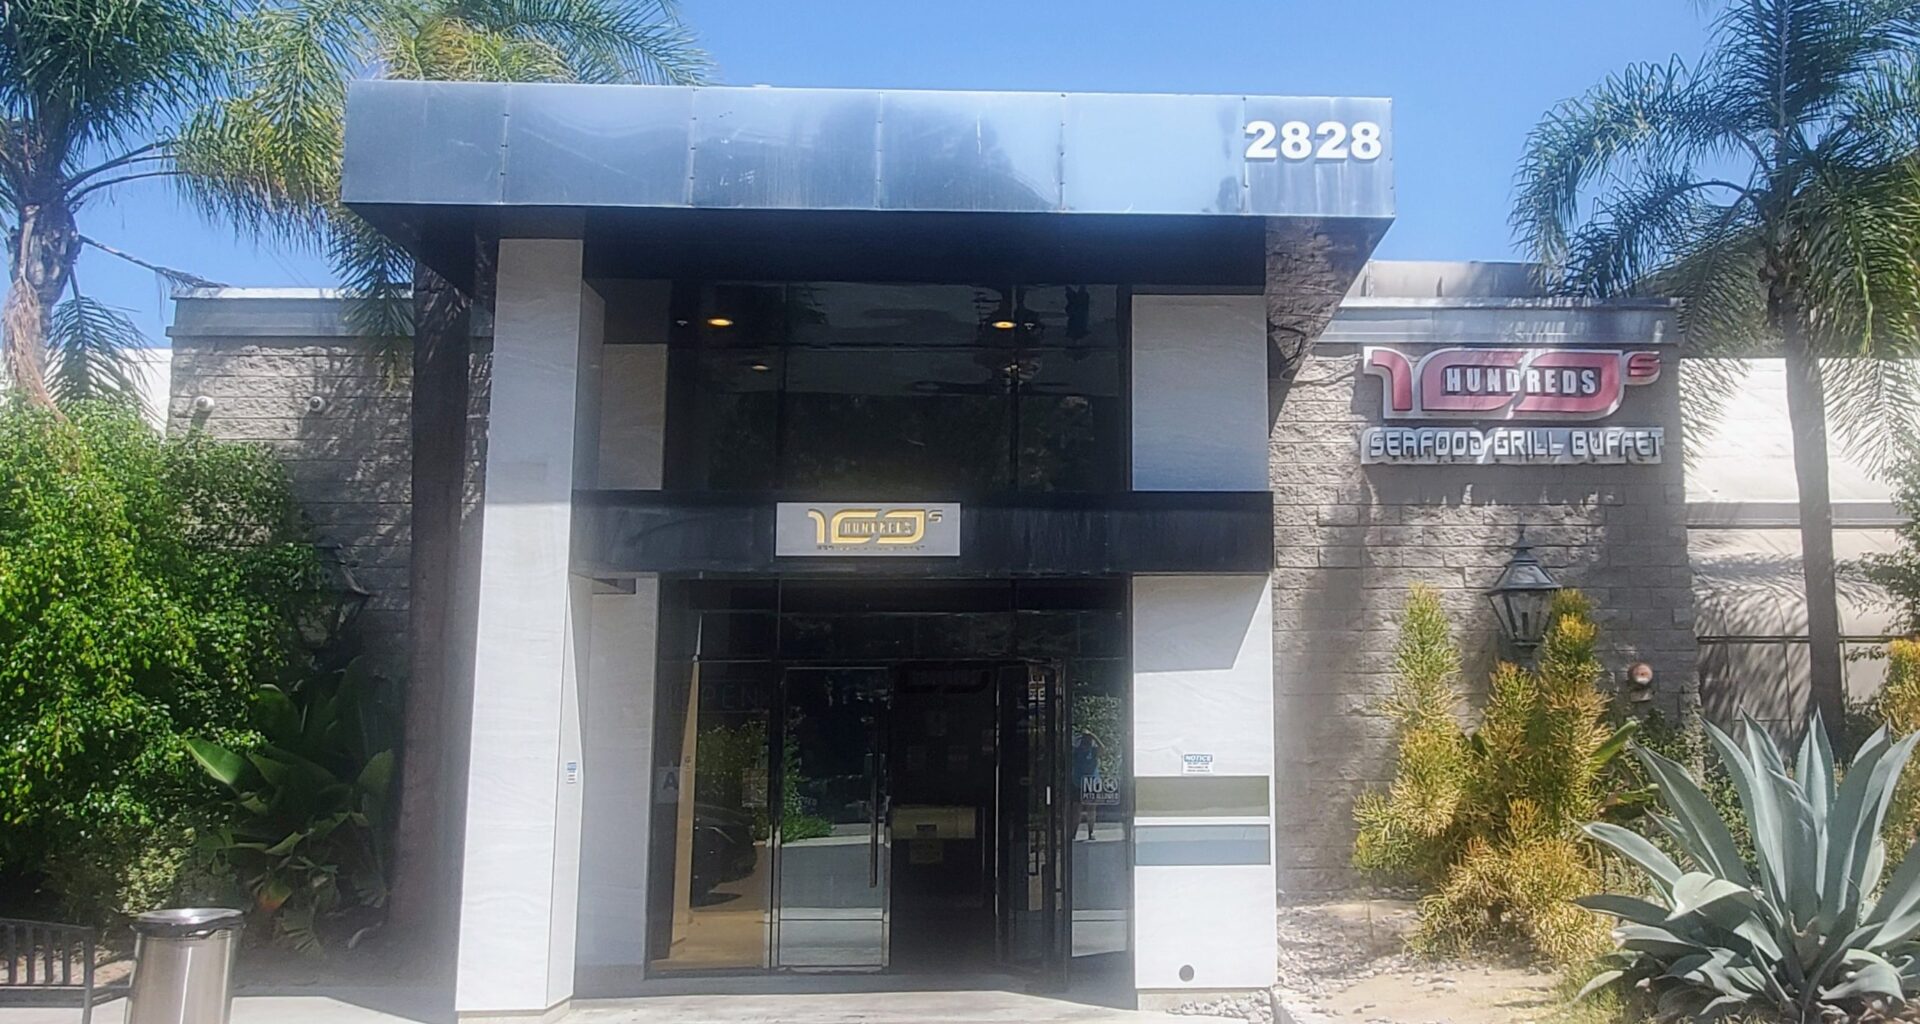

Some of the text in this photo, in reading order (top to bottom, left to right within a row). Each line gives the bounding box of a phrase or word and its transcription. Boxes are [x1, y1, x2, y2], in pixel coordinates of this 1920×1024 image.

[1244, 120, 1383, 160] 2828
[1446, 367, 1597, 394] HUNDREDS
[1369, 430, 1664, 457] SEAFOOD GRILL BUFFET
[1083, 776, 1103, 793] NO
